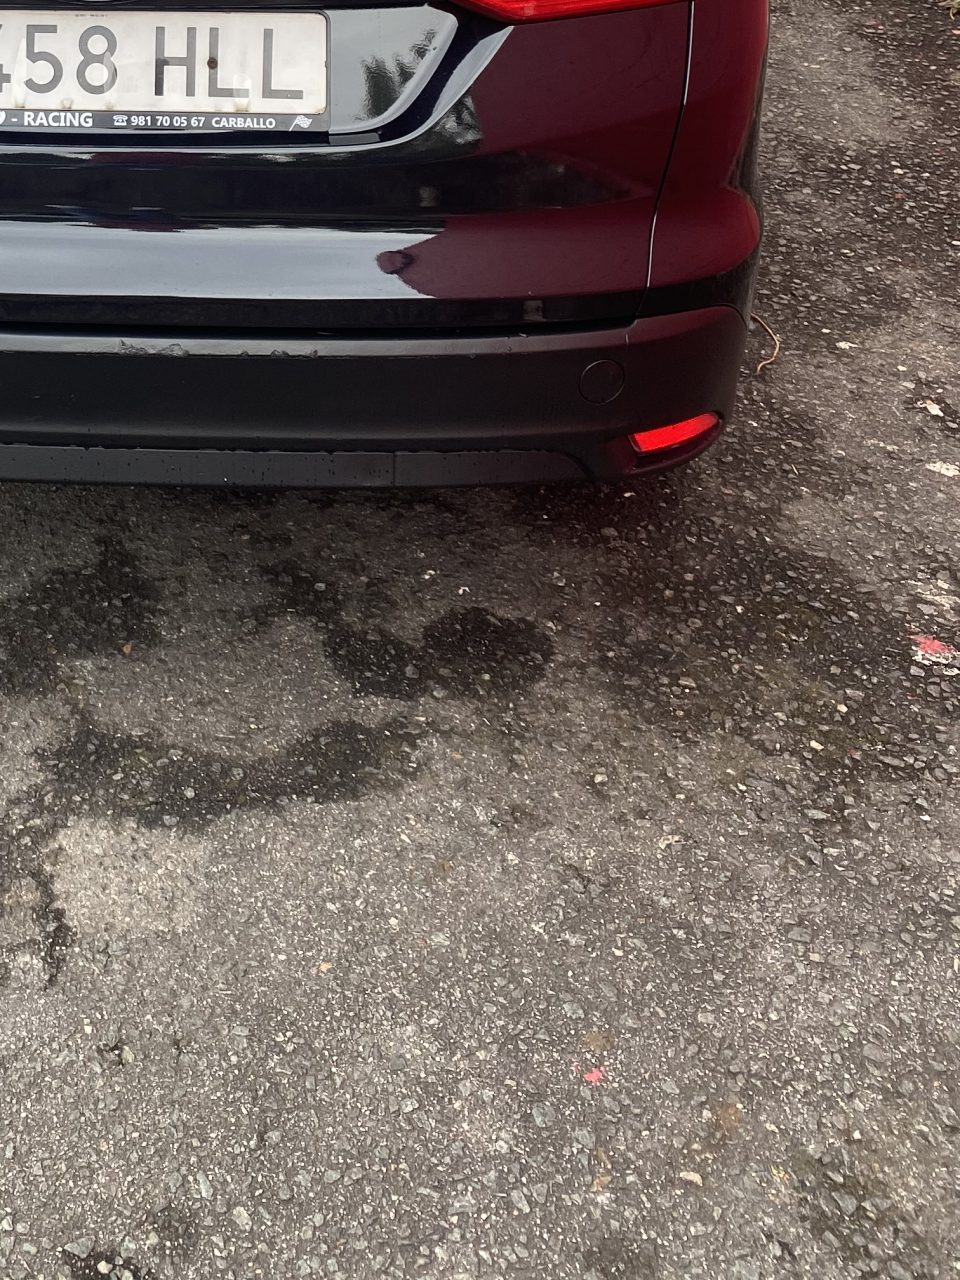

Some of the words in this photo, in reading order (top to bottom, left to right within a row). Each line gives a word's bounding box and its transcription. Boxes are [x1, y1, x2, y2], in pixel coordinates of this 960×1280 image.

[154, 25, 304, 101] HLL
[23, 111, 93, 127] RACING
[130, 115, 152, 126] 981
[155, 115, 169, 127] 70
[173, 116, 188, 127] 05
[191, 116, 206, 128] 67
[211, 117, 276, 129] CARBALLO
